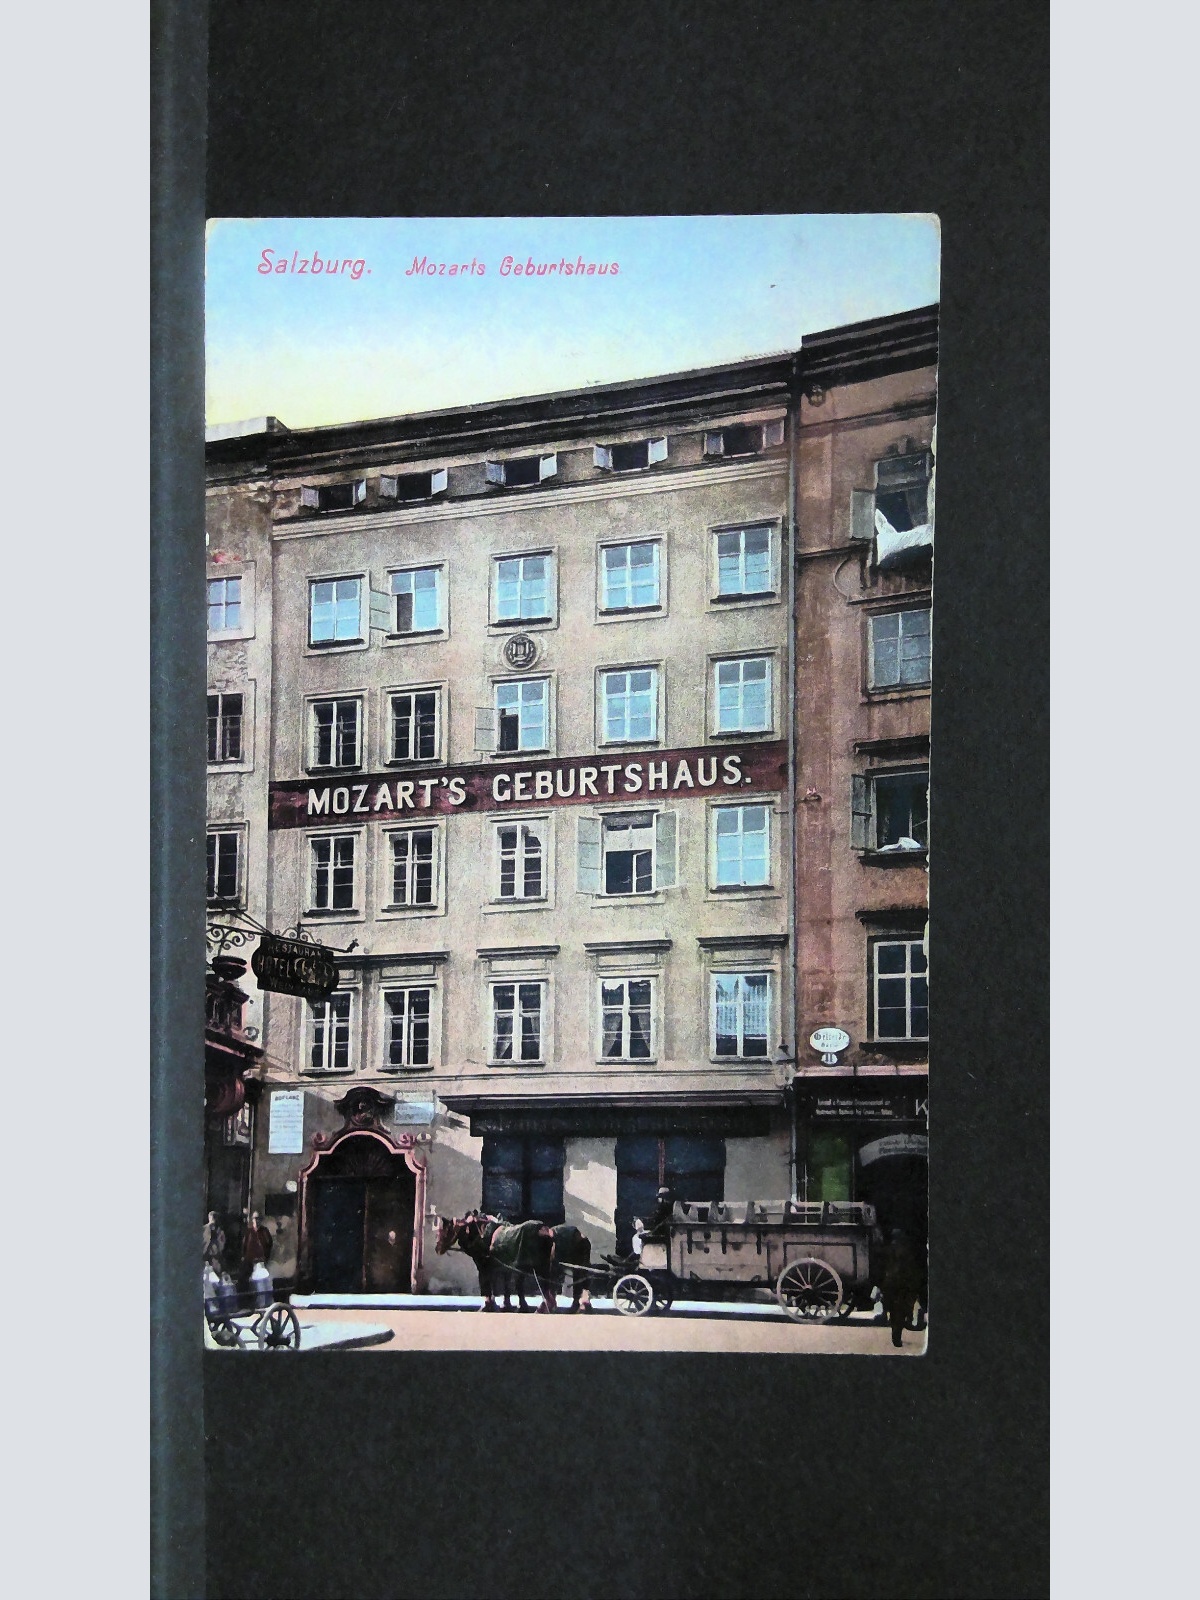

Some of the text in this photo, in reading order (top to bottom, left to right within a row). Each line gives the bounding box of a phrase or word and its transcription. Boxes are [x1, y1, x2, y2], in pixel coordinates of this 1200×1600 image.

[257, 248, 620, 280] Salzburg. Mozarts Geburtshaus
[306, 754, 753, 816] MOZART'S GEBURTSHAUS.
